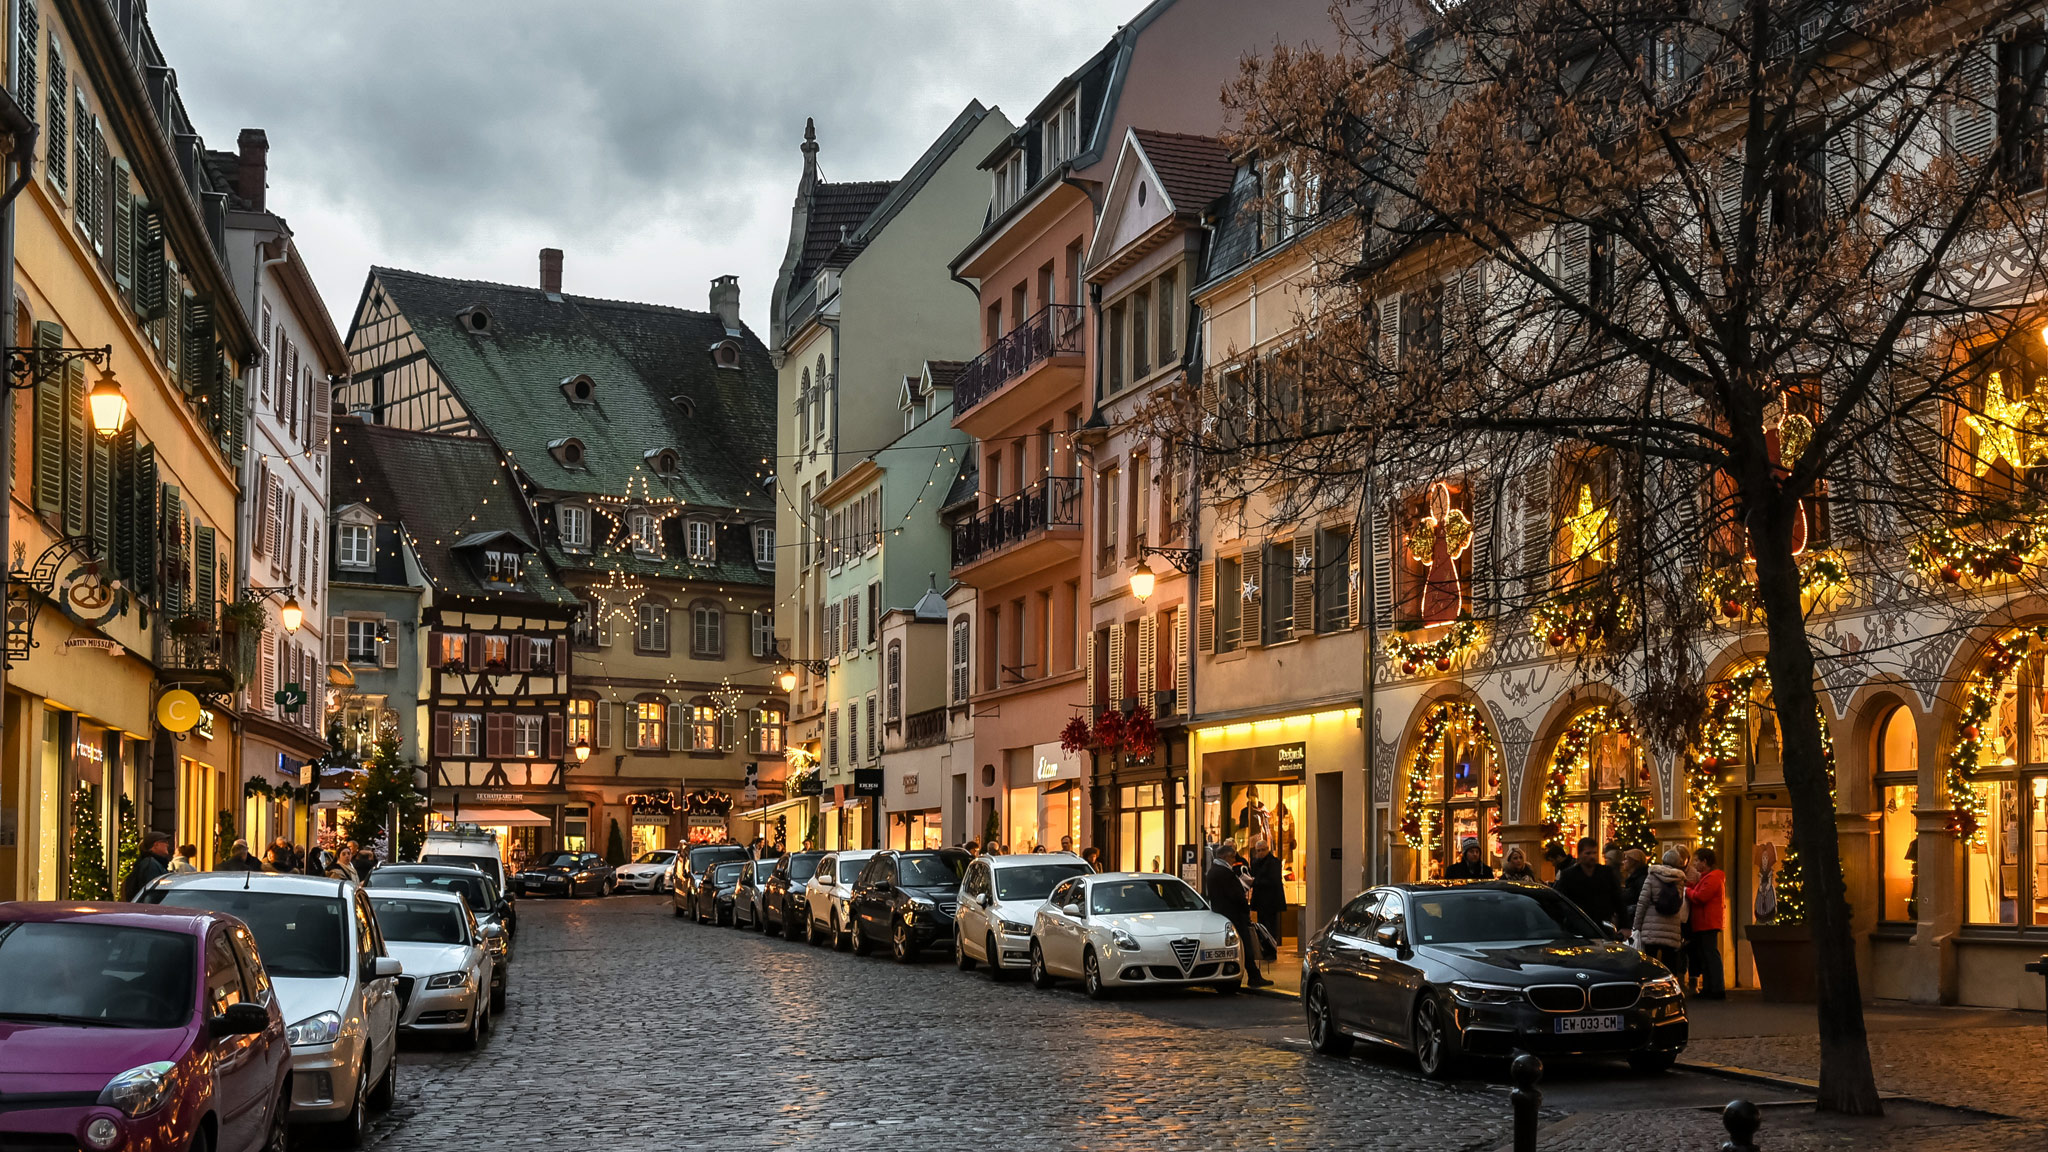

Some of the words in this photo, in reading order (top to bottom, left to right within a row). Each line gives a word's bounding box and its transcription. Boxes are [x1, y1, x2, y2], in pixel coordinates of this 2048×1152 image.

[64, 639, 87, 648] MARTIN
[169, 700, 187, 720] C
[1186, 851, 1194, 863] P
